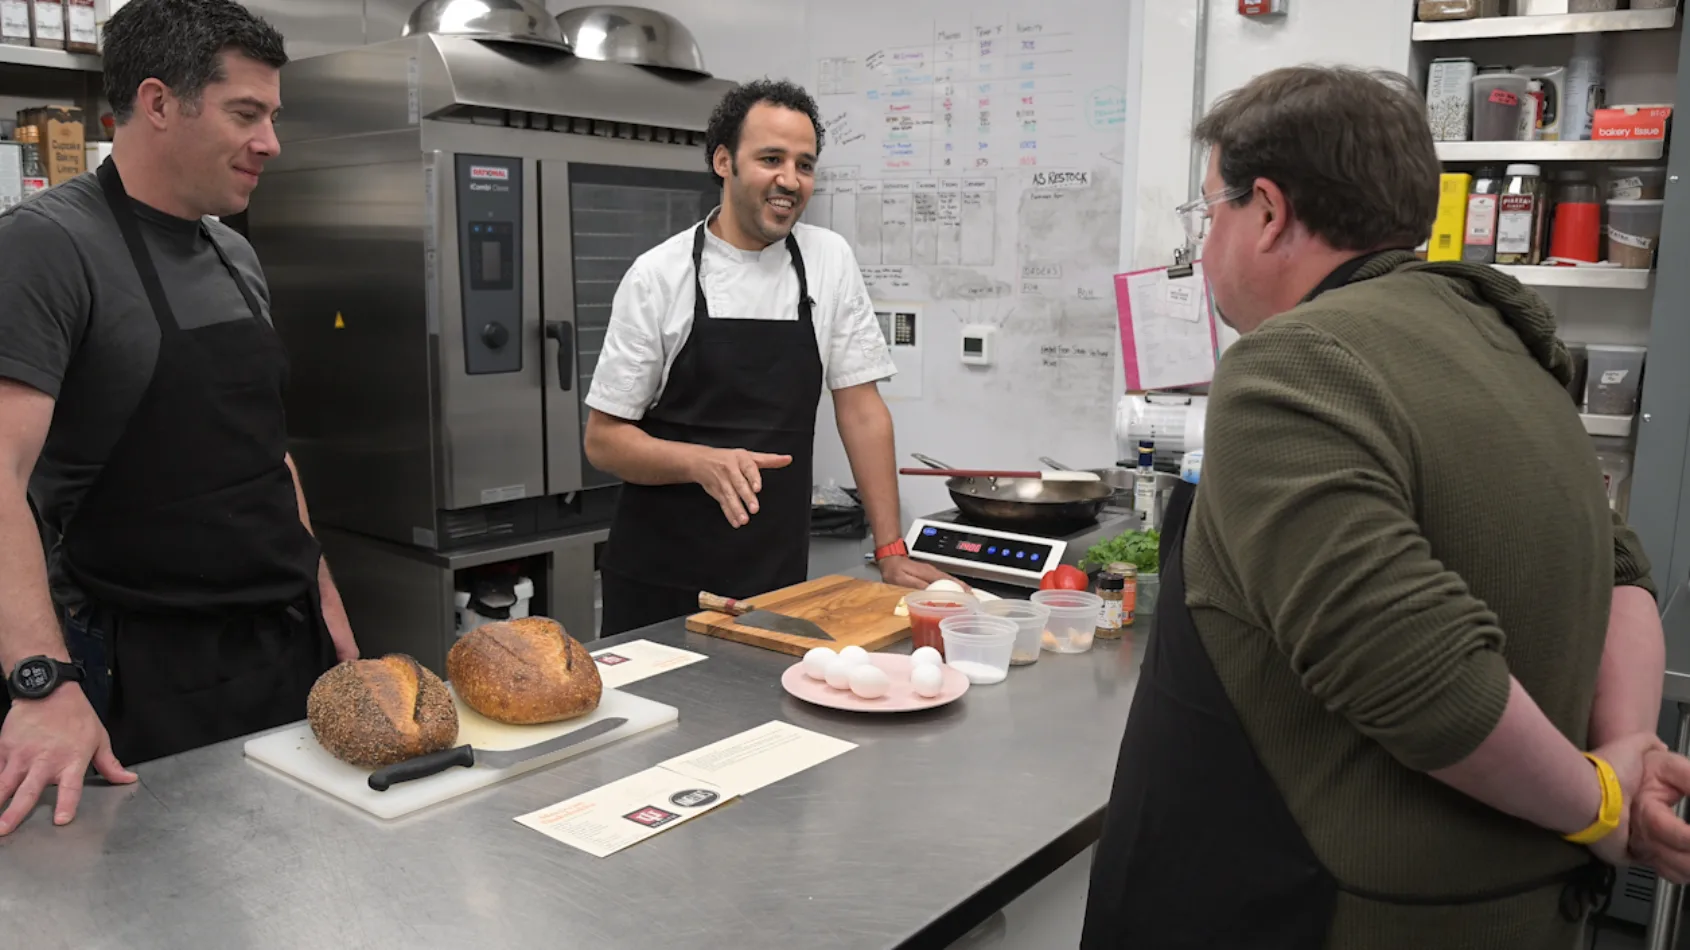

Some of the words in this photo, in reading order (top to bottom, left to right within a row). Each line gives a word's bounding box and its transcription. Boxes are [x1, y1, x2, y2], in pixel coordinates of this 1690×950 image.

[1599, 127, 1630, 138] bakery
[1634, 125, 1659, 136] tissue
[52, 140, 81, 151] Cupcake
[56, 152, 79, 164] Baking
[58, 165, 79, 174] Liners
[473, 168, 505, 178] RATIONAL
[1048, 171, 1087, 184] RESTOCK
